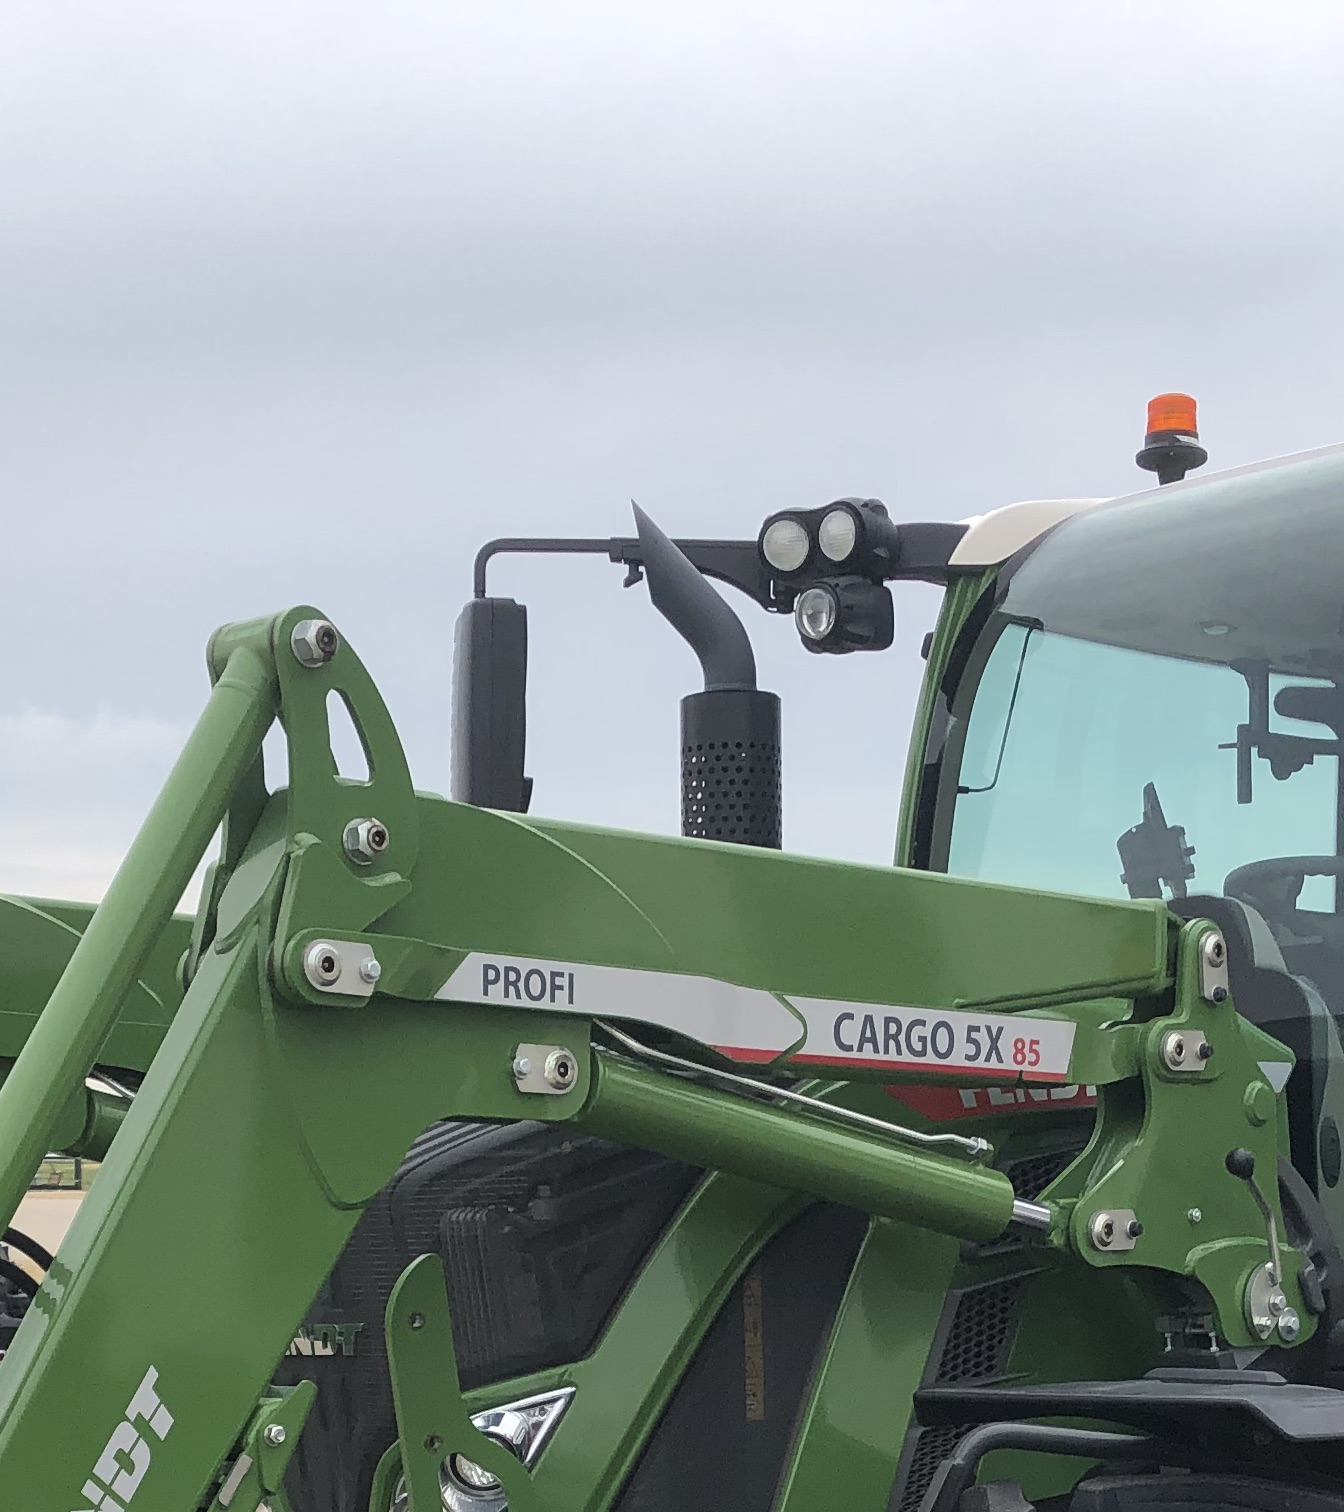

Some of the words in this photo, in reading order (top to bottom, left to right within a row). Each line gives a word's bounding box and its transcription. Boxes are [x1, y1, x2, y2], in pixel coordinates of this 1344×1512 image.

[481, 963, 575, 1005] PROFI
[832, 1012, 954, 1060] CARGO
[963, 1023, 1005, 1065] 5X
[1012, 1037, 1041, 1067] 85
